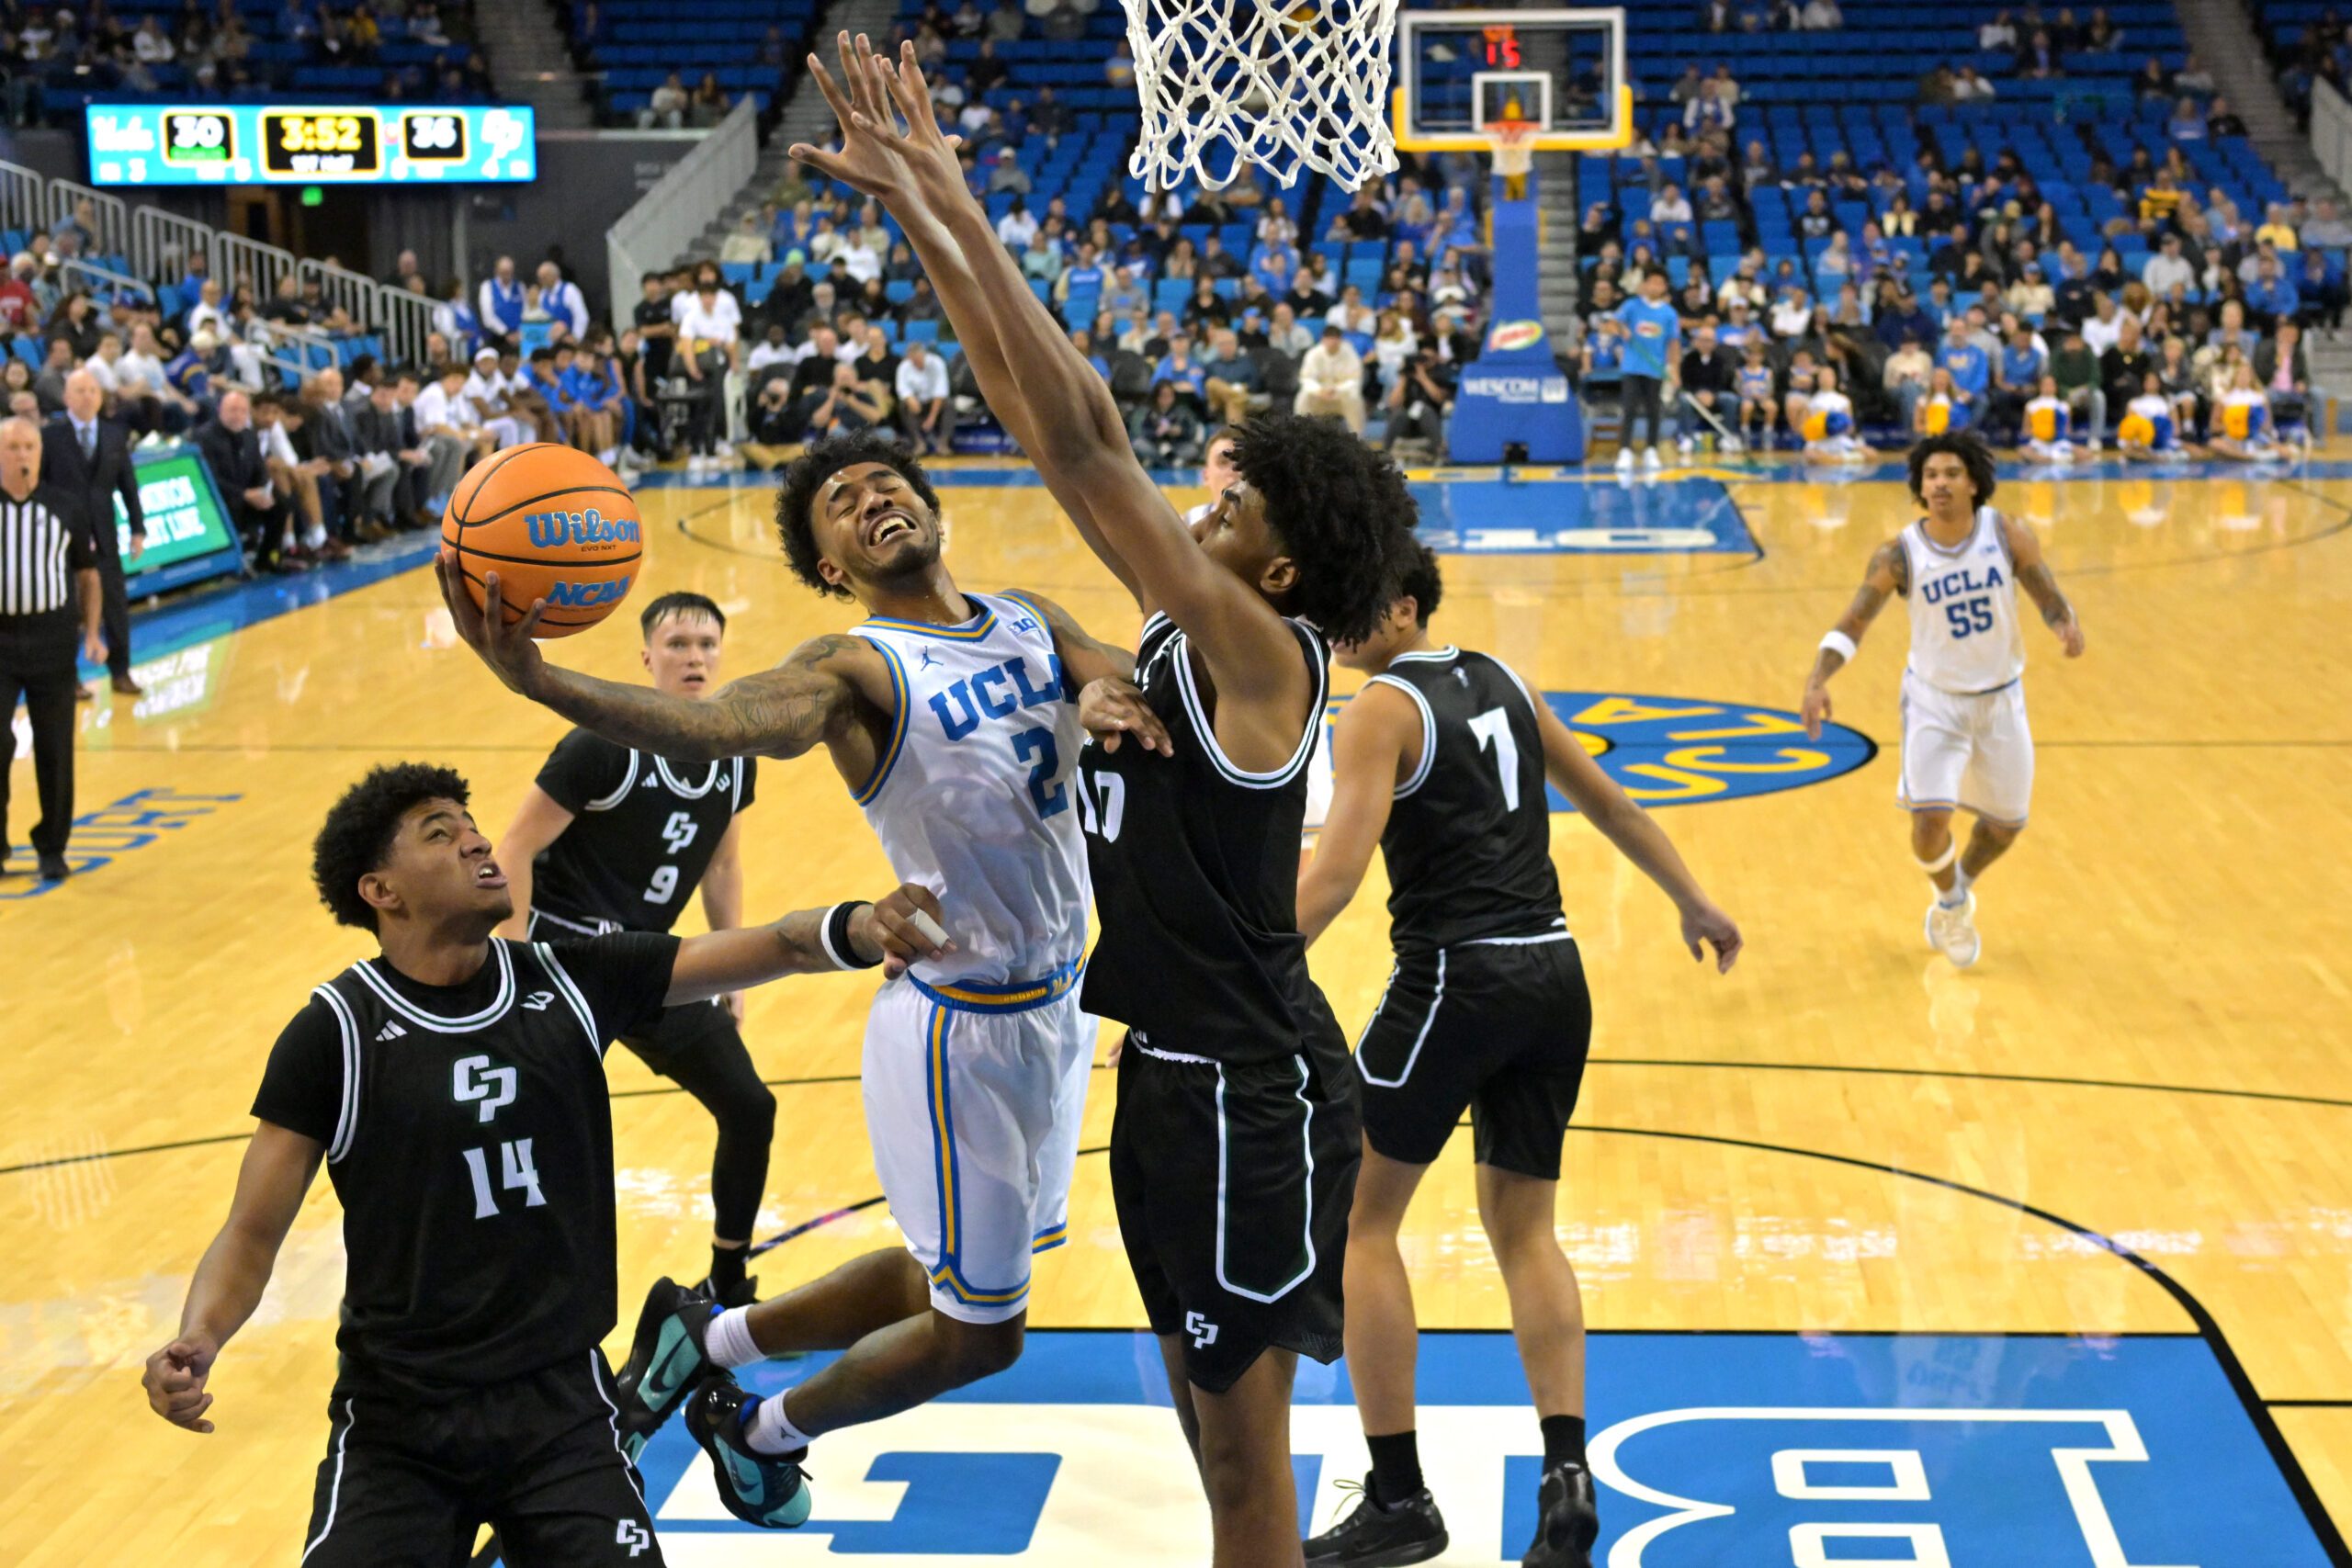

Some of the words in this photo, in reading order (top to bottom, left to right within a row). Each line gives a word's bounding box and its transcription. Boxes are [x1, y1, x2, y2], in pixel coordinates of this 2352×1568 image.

[1487, 40, 1521, 68] 15
[172, 115, 225, 149] 30
[280, 116, 362, 152] 3:52
[411, 115, 458, 149] 36
[1464, 378, 1540, 397] WESCOM
[524, 508, 640, 548] Wilson
[1921, 566, 2004, 604] UCLA
[1945, 596, 1994, 640] 55
[928, 654, 1077, 741] UCLA
[1010, 726, 1069, 820] 2
[1467, 706, 1520, 812] 7
[644, 865, 679, 905] 9
[453, 1055, 517, 1123] CP
[462, 1137, 548, 1220] 14
[1185, 1310, 1219, 1349] CP
[616, 1518, 650, 1557] CP
